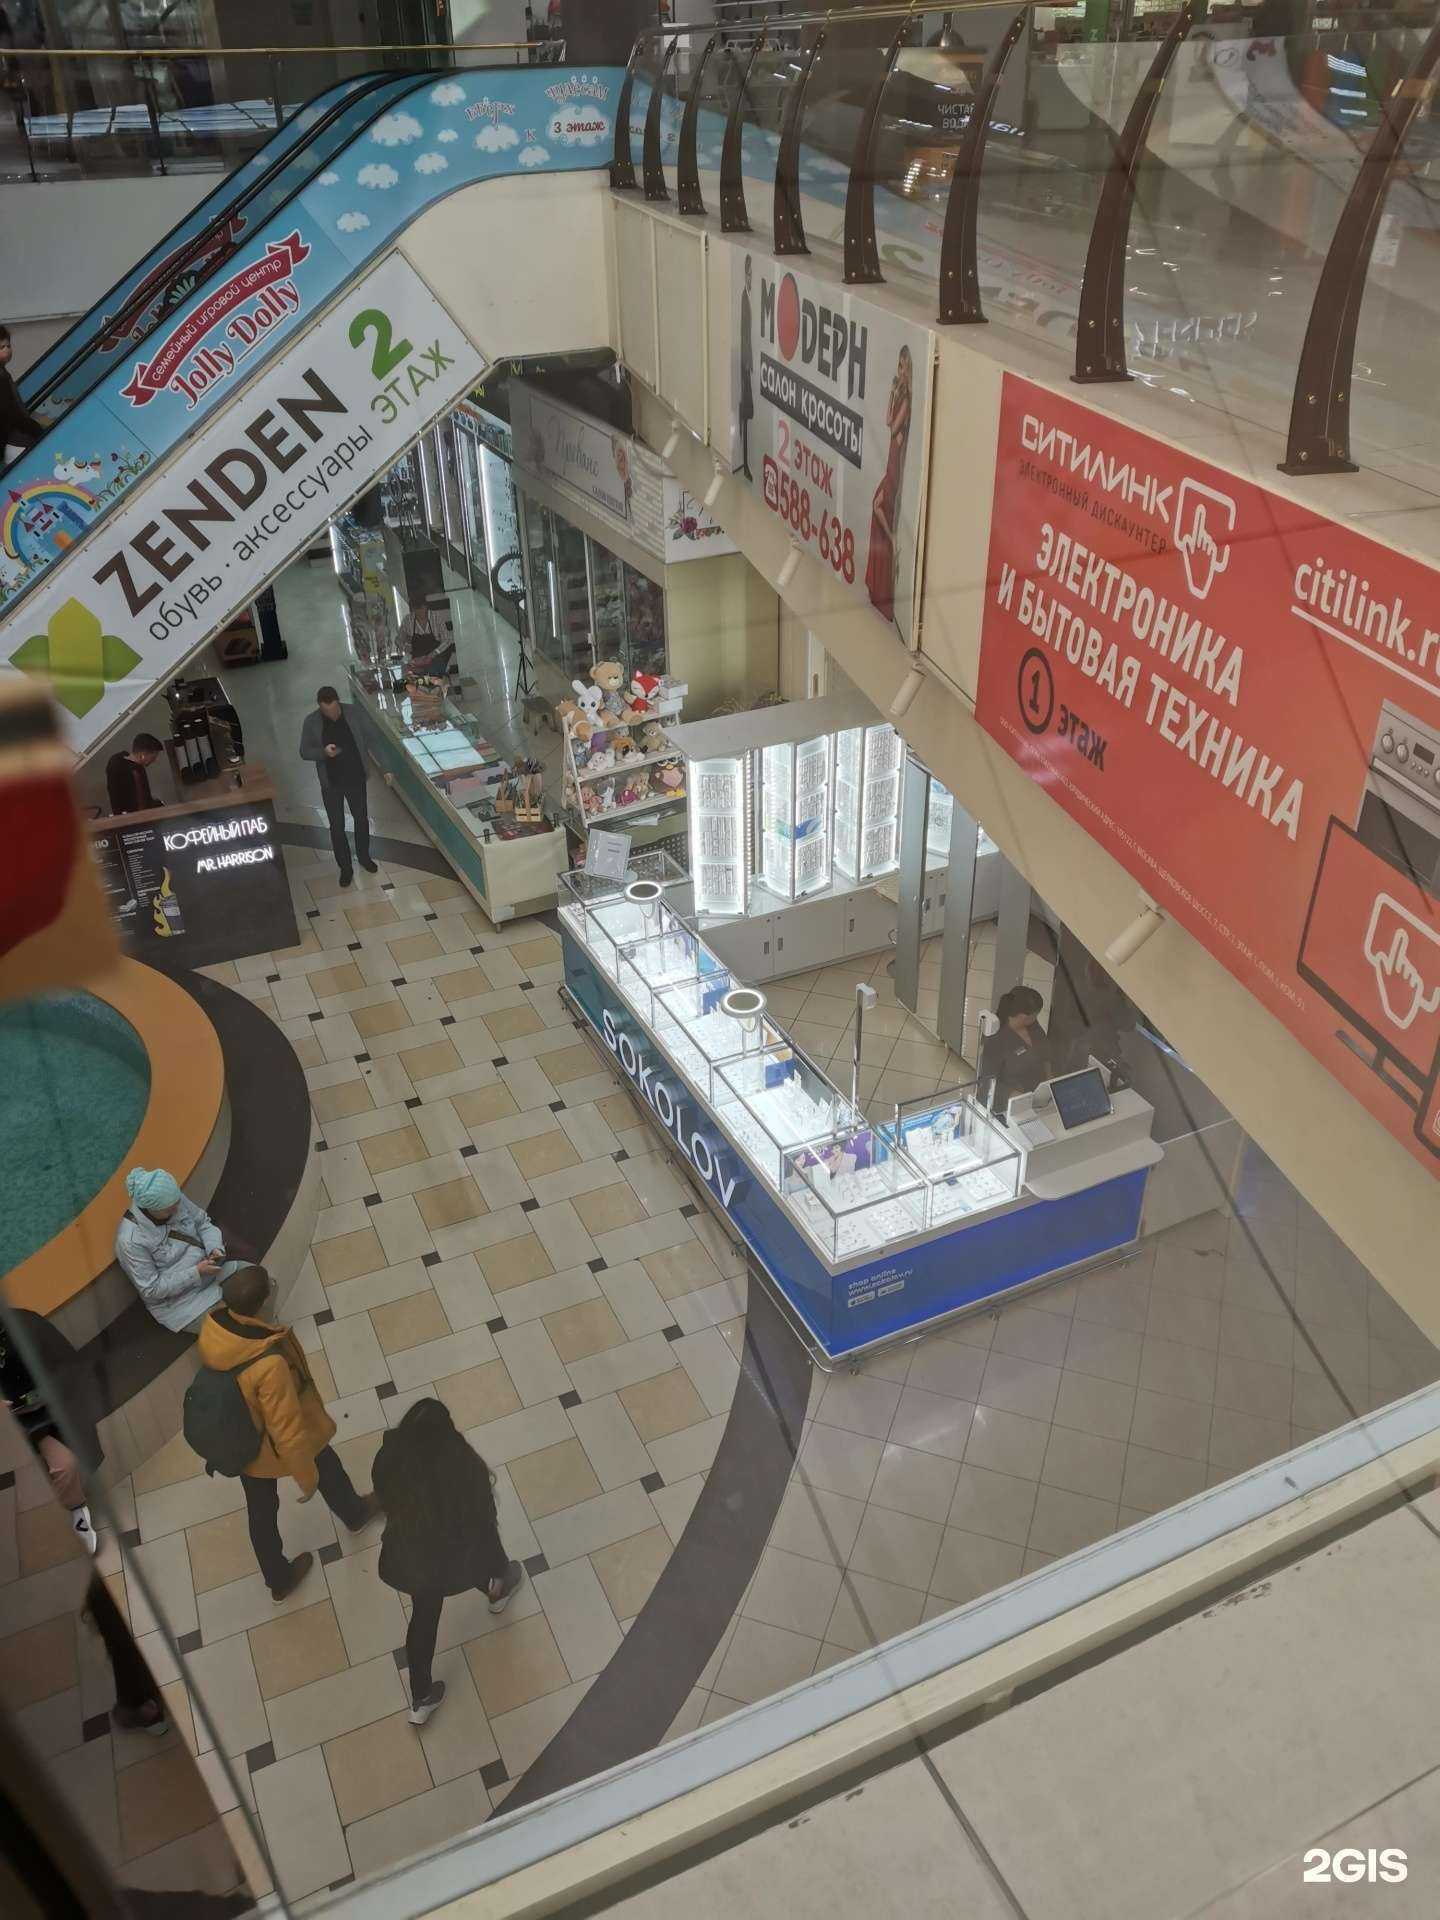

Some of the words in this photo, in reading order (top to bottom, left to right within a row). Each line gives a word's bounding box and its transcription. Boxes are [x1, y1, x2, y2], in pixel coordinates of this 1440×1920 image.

[566, 120, 606, 134] этаж
[151, 323, 197, 382] семейный
[198, 283, 240, 327] игровой
[240, 258, 282, 289] центр
[170, 342, 236, 410] Jolly
[226, 281, 300, 346] Dolly
[348, 308, 414, 381] 2
[370, 339, 455, 425] ЭТАЖ
[760, 361, 796, 409] салон
[800, 386, 863, 457] красоты
[92, 367, 348, 618] ZENDEN
[777, 419, 790, 467] 2
[794, 439, 834, 499] этаж
[1019, 459, 1089, 511] ЭЛЕКТРОННЫЙ
[1090, 500, 1167, 555] ДИСКАУНТЕР
[1021, 414, 1174, 523] СИТИЛИНК
[149, 572, 224, 641] обувь
[232, 425, 374, 562] аксессуары
[779, 469, 855, 585] 588-638
[1036, 523, 1244, 707] ЭЛЕКТРОНИКА
[1294, 557, 1440, 678] citilink.r
[997, 562, 1017, 611] И
[1017, 579, 1142, 709] БЫТОВАЯ
[1145, 672, 1304, 842] ТЕХНИКА
[1028, 670, 1040, 714] 1
[1057, 703, 1108, 772] этаж
[163, 820, 241, 851] КОФЕЙНЫЙ
[241, 816, 269, 837] ПАБ
[196, 858, 218, 874] MR.
[218, 847, 274, 869] HARRISON
[603, 1008, 736, 1209] SOKOLOV
